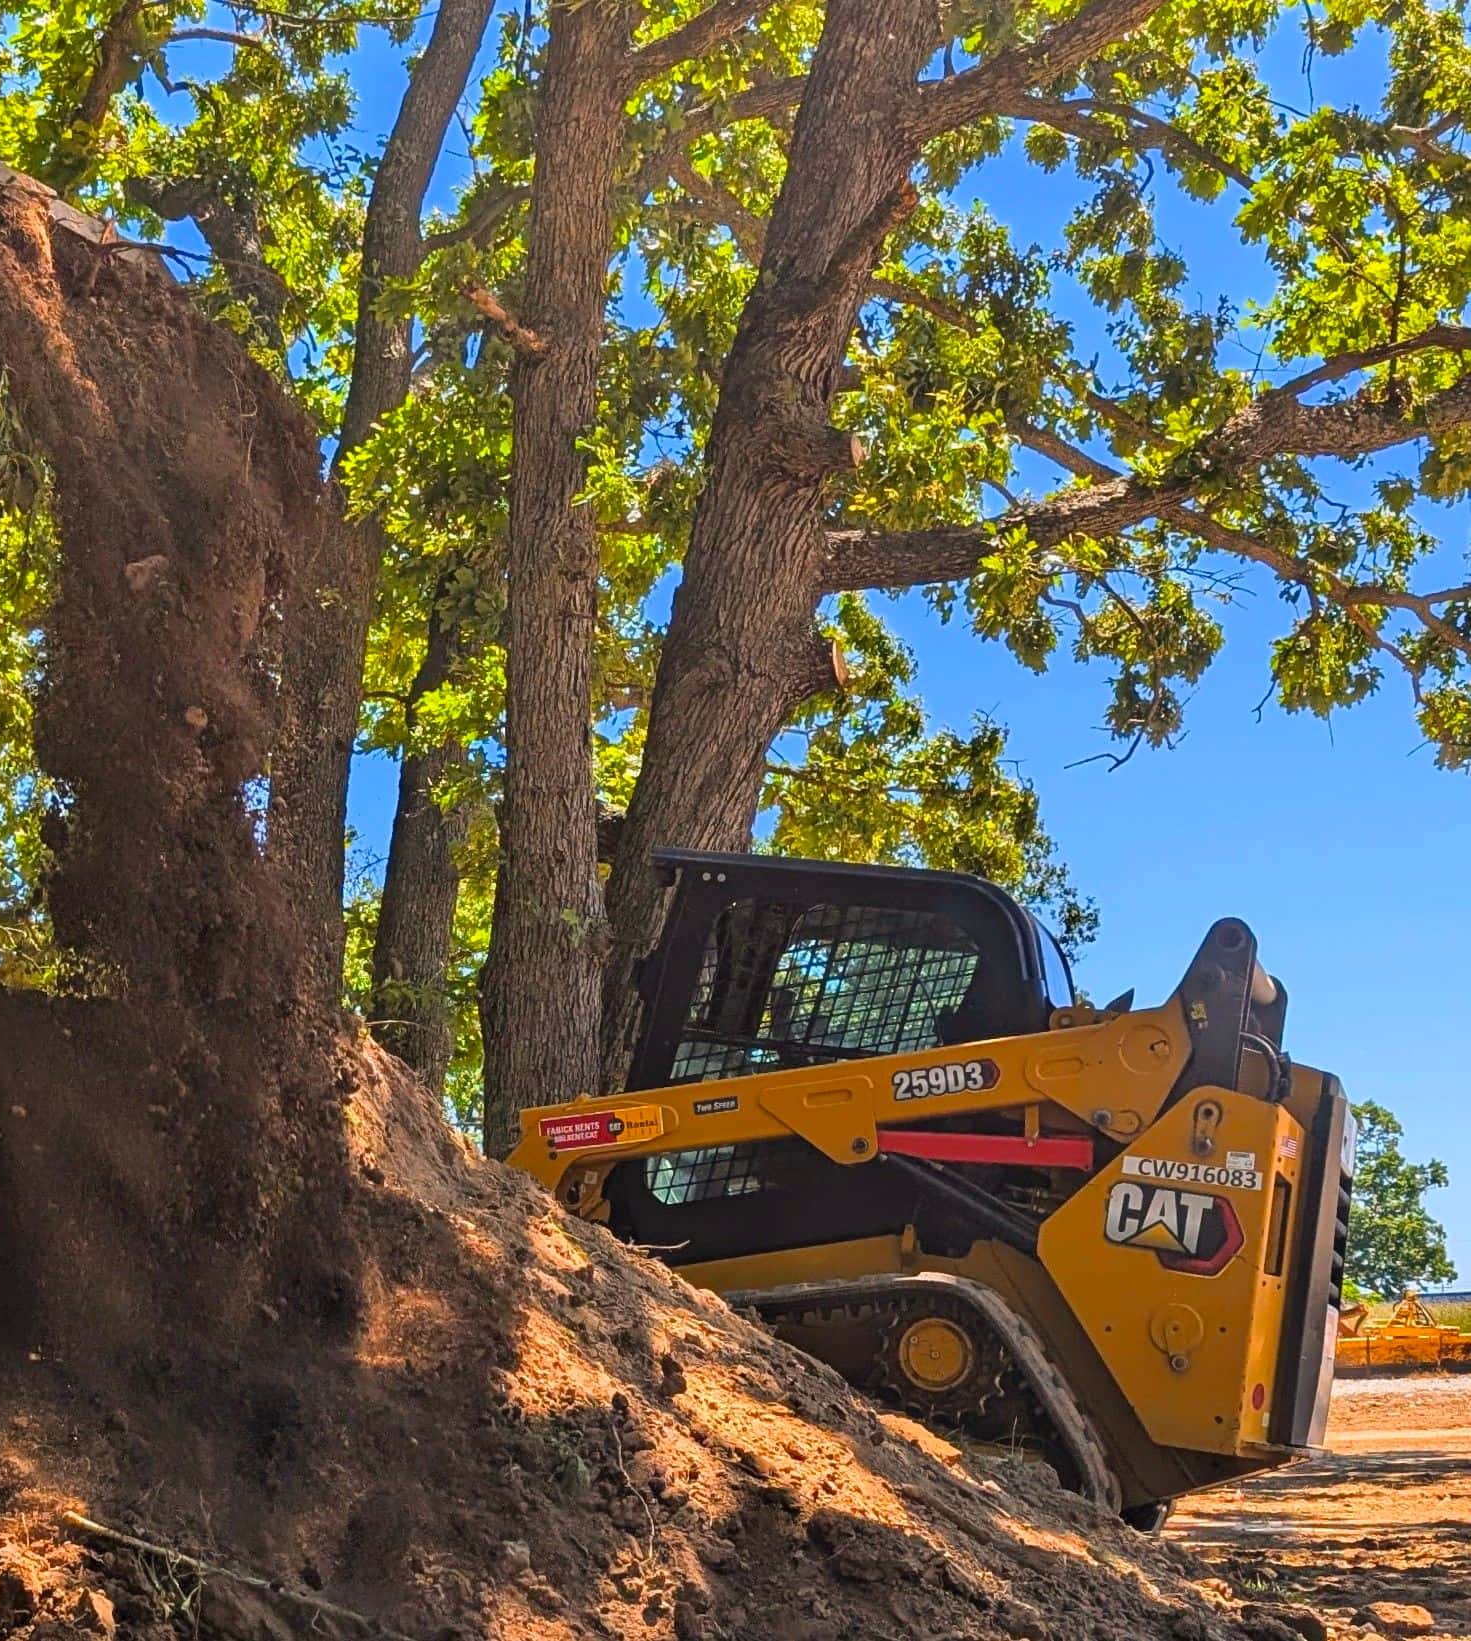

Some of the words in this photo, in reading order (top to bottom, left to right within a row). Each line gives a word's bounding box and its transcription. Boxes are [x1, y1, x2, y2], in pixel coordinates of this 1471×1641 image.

[893, 1062, 985, 1100] 259D3
[1138, 1159, 1257, 1190] CW916083
[1105, 1182, 1215, 1254] CAT
